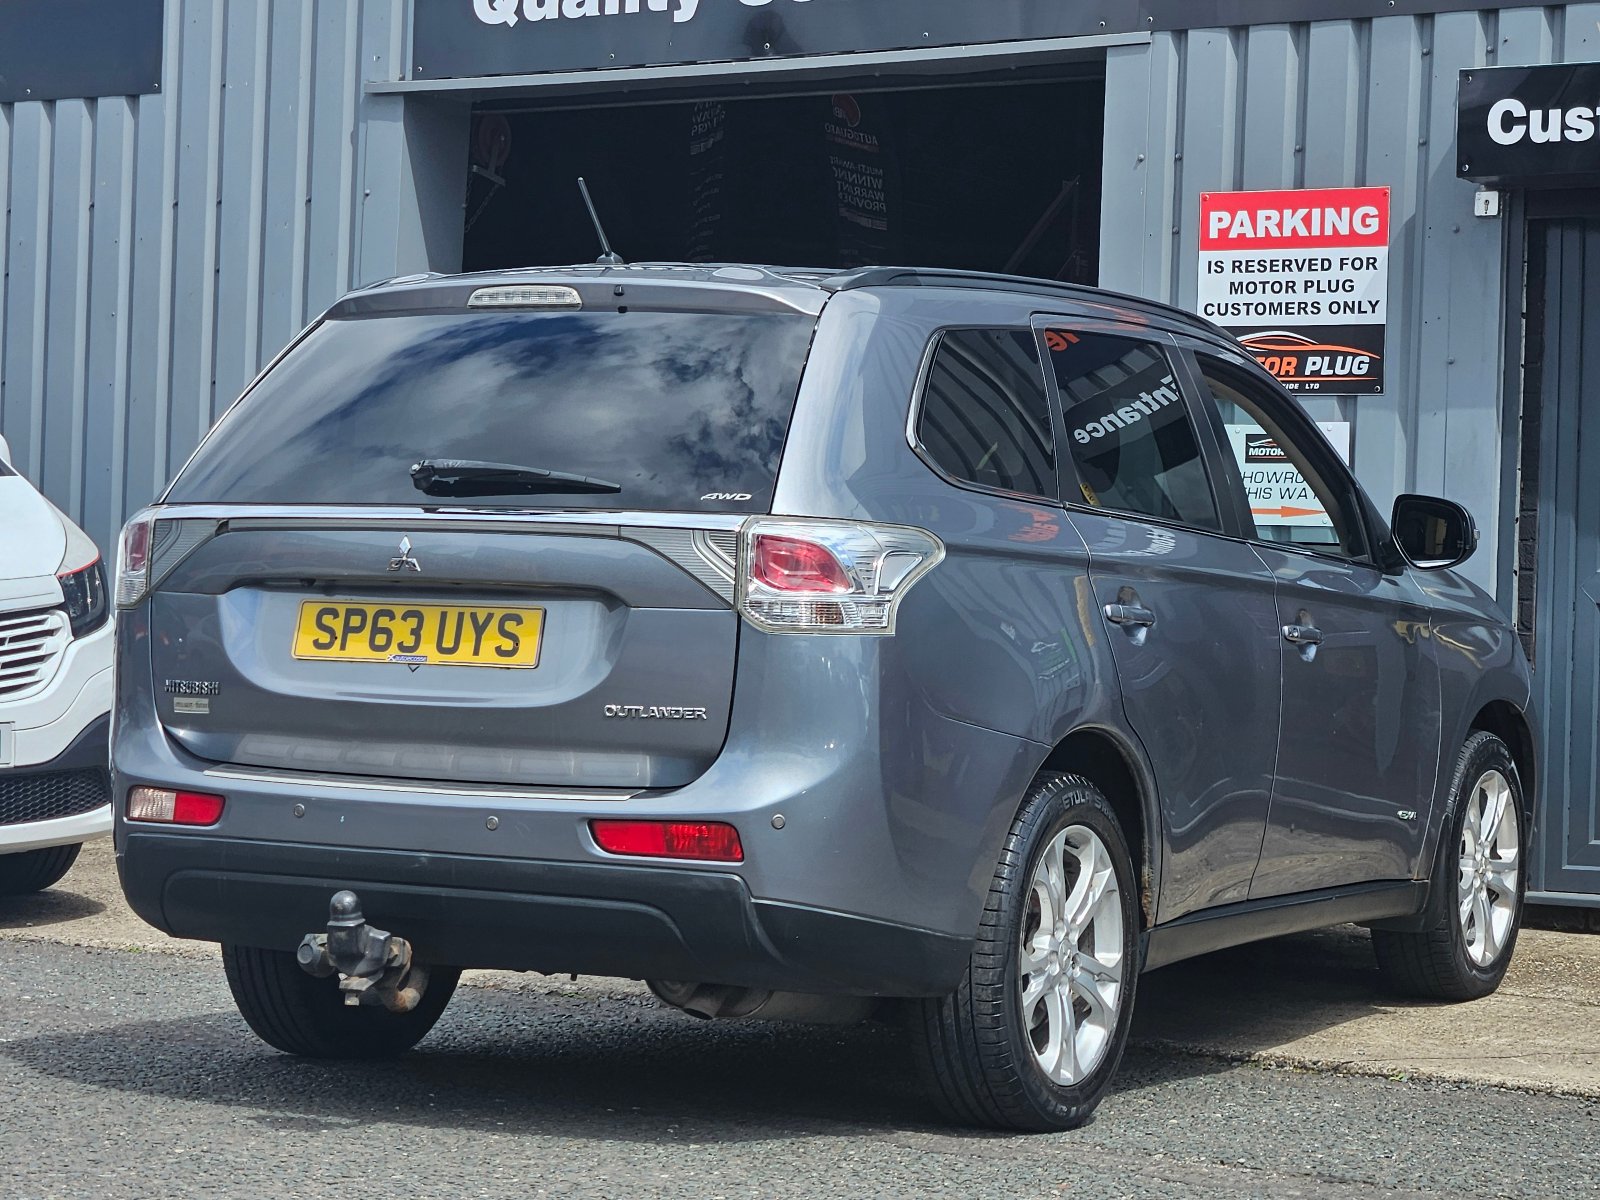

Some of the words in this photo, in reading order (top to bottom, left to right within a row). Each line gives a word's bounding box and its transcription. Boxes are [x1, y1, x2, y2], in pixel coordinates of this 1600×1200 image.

[473, 0, 701, 28] Quay
[1487, 98, 1600, 145] Cus
[1209, 206, 1379, 239] PARKING
[1207, 260, 1225, 274] IS
[1231, 258, 1331, 273] RESERVED
[1339, 256, 1378, 271] FOR
[1229, 280, 1297, 295] MOTOR
[1303, 279, 1355, 294] PLUG
[1203, 302, 1320, 316] CUSTOMERS
[1328, 299, 1381, 315] ONLY
[1304, 355, 1370, 376] PLUG
[1241, 471, 1305, 484] HOWRO
[1244, 487, 1273, 500] HIS
[312, 607, 425, 654] SP63
[435, 610, 524, 658] UYS
[164, 679, 220, 695] MITSUBISHI
[604, 704, 707, 720] OUTLANDER
